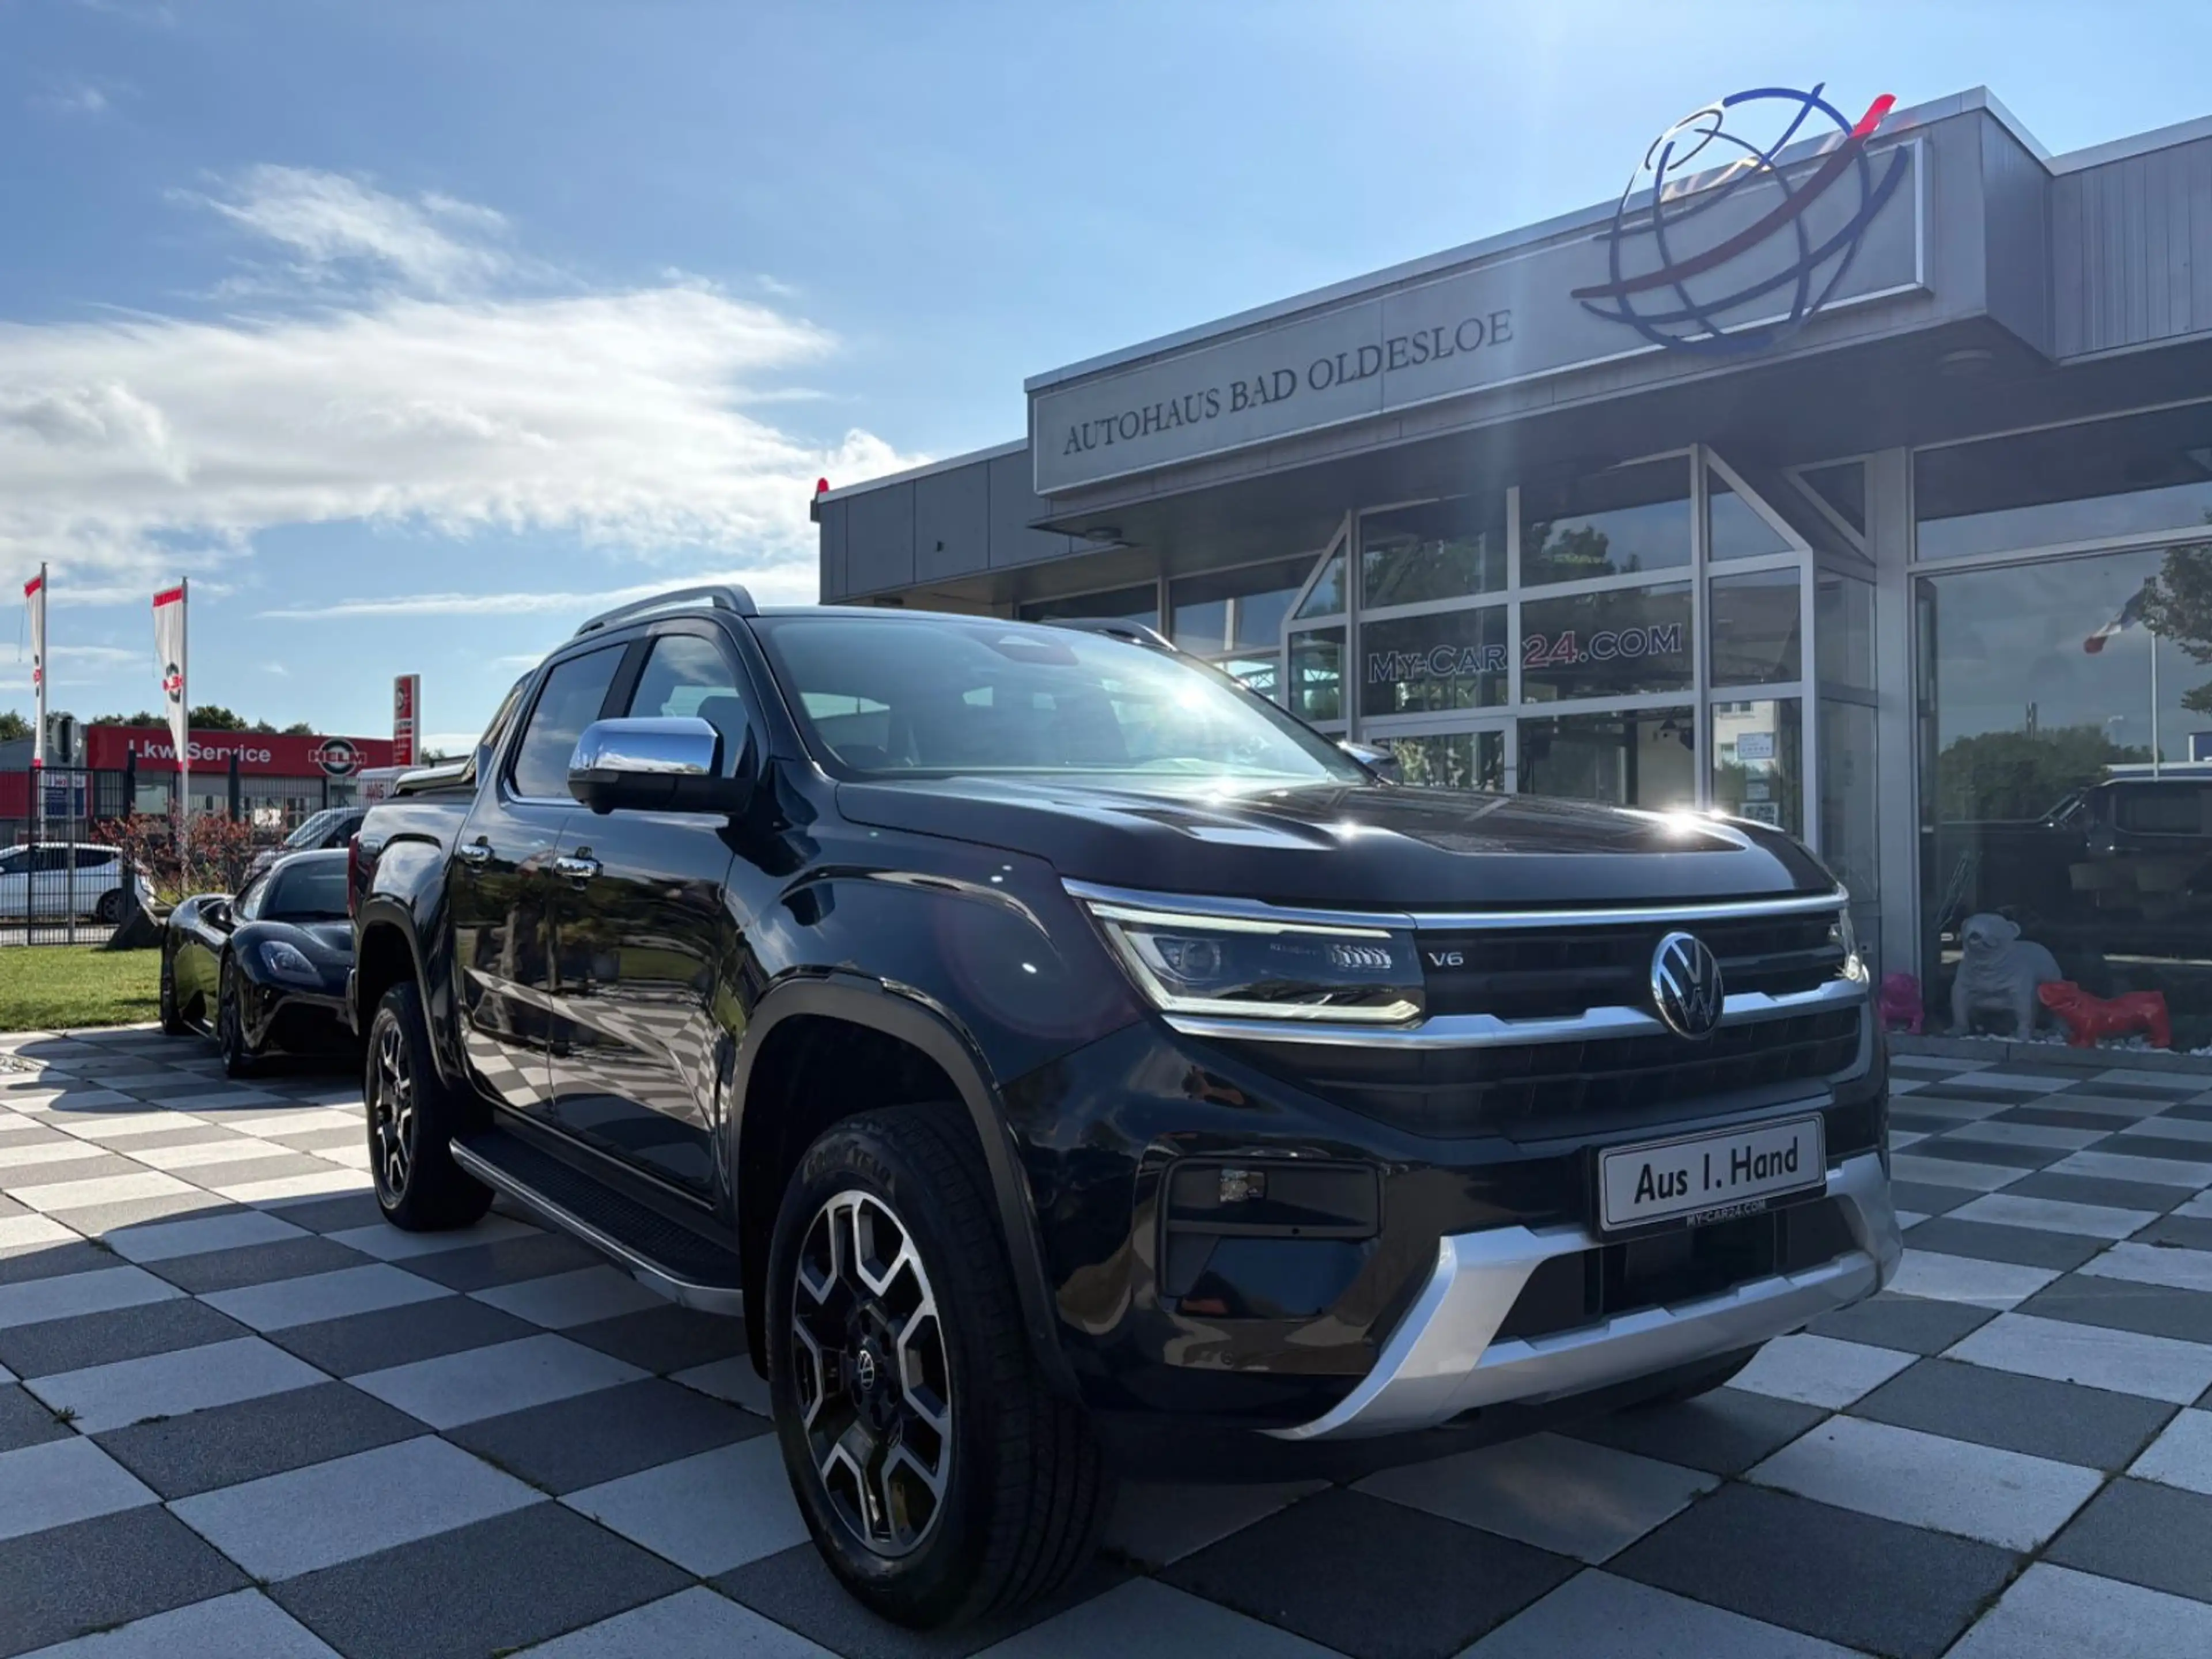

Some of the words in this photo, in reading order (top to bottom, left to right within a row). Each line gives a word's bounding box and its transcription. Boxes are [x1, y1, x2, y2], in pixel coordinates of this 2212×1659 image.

[1062, 388, 1221, 455] AUTOHAUS
[1229, 368, 1297, 413] BAD
[1308, 309, 1513, 391] OLDESLOE
[187, 742, 271, 763] Service
[308, 749, 367, 765] HELM
[1428, 952, 1464, 967] V6
[1634, 1163, 1688, 1205] Aus
